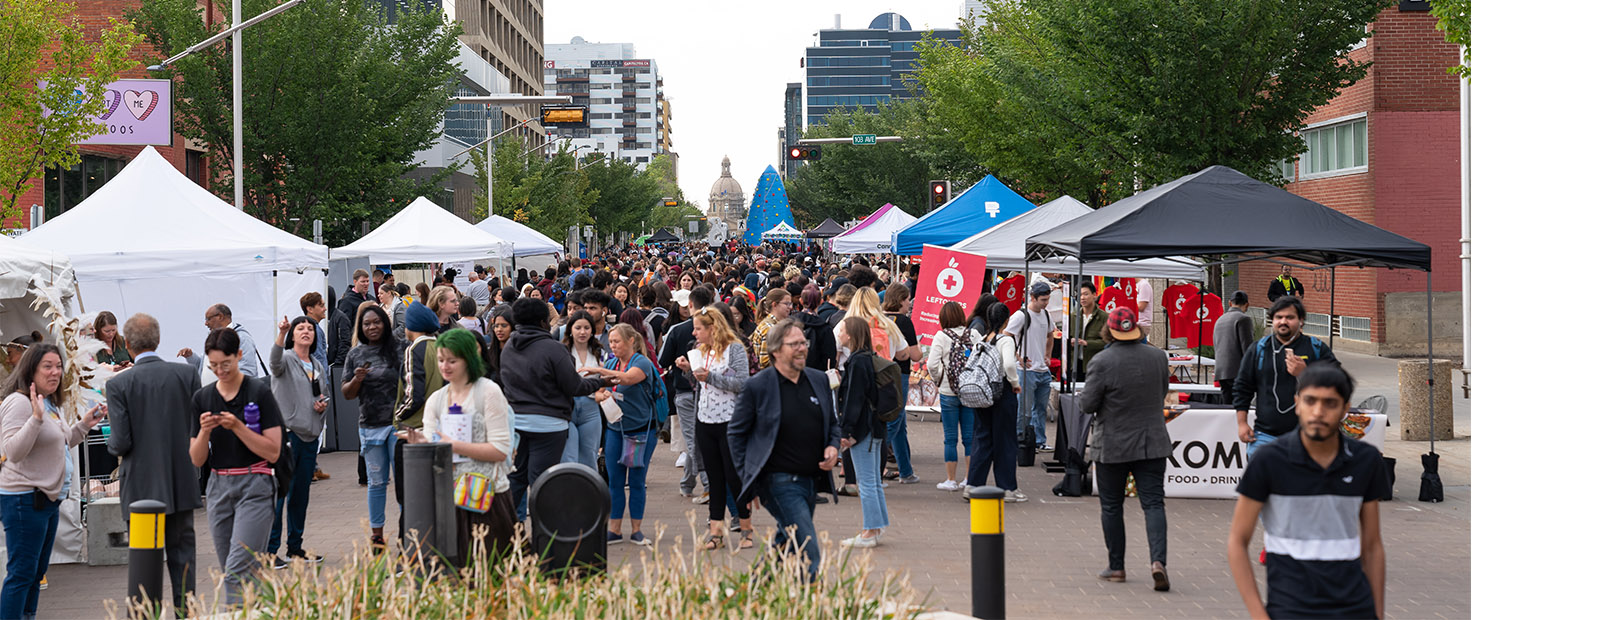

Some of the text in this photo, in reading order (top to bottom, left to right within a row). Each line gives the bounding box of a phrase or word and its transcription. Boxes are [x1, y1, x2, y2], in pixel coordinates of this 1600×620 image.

[133, 100, 144, 108] ME
[926, 295, 967, 309] LEFTORS
[1168, 440, 1248, 469] KOM
[1168, 475, 1200, 484] FOOD
[1210, 475, 1241, 485] DRIN
